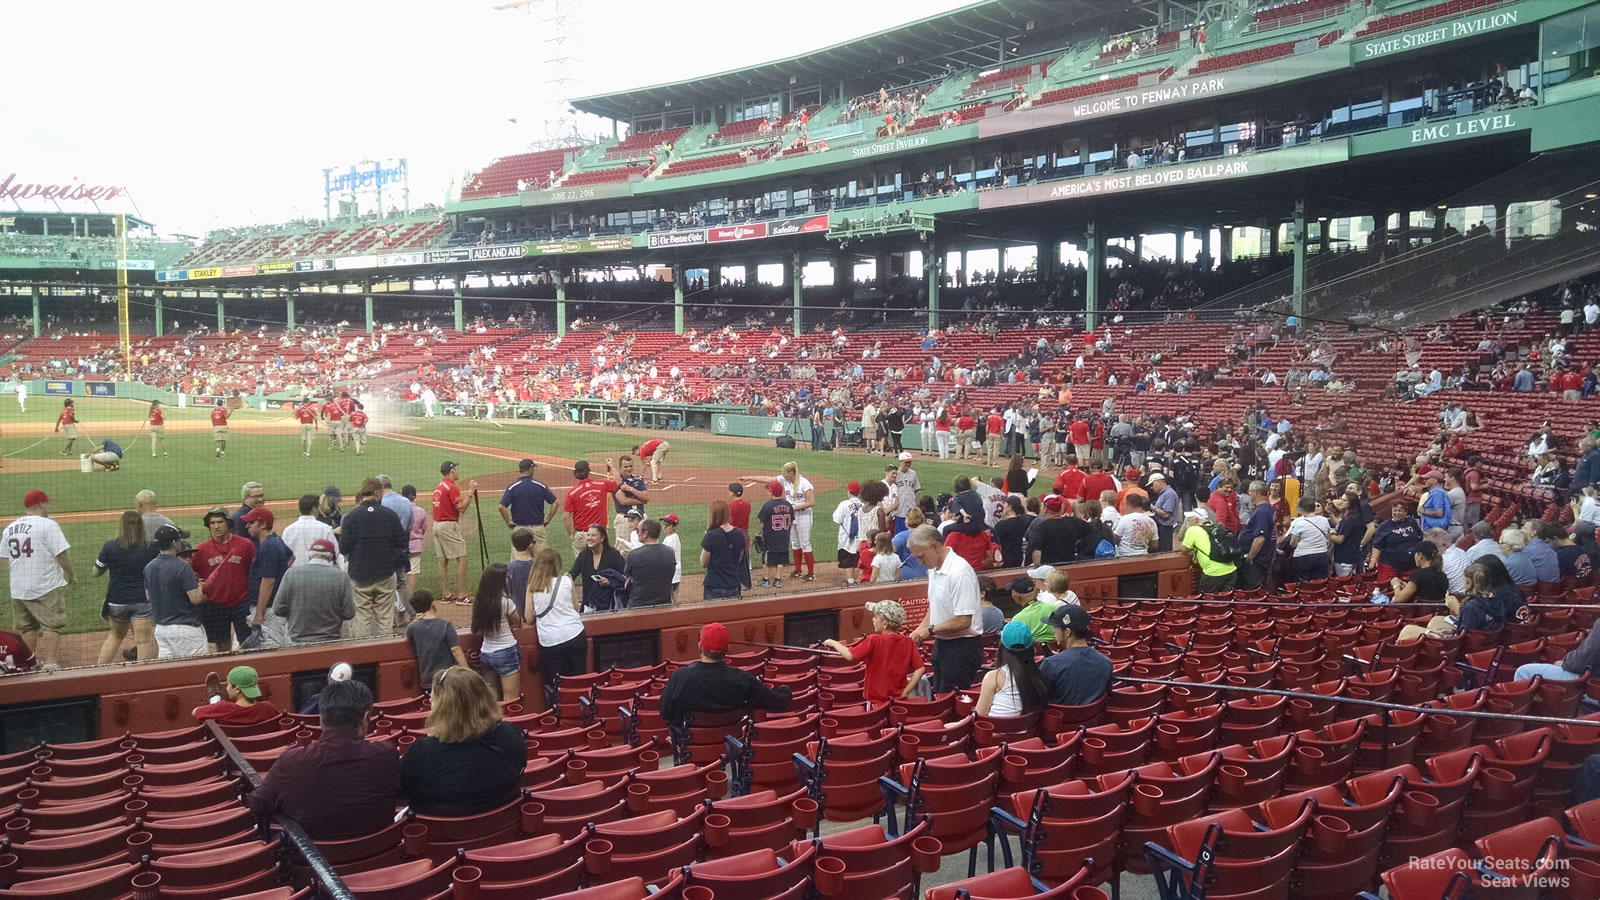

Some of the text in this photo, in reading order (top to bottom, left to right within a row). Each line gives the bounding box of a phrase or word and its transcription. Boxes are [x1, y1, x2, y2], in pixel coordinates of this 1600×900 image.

[1365, 10, 1518, 57] STATE STREET PAVILION
[1073, 78, 1225, 117] WELCOME TO FENWAY PARK
[1411, 115, 1516, 143] EMC LEVEL
[852, 137, 928, 157] STATE STREET PAVILION
[1050, 161, 1249, 197] AMERICA'S MOST BELOVED BALLPARK
[551, 189, 595, 201] JUNE 22, 2016
[772, 225, 800, 235] Safelite
[660, 233, 702, 244] The Boston Globe
[474, 248, 491, 259] ALEX
[491, 247, 507, 258] AND
[1247, 464, 1257, 477] 18
[8, 523, 33, 537] ORTIZ
[771, 514, 791, 531] 50
[8, 537, 34, 559] 34
[1202, 850, 1210, 861] G
